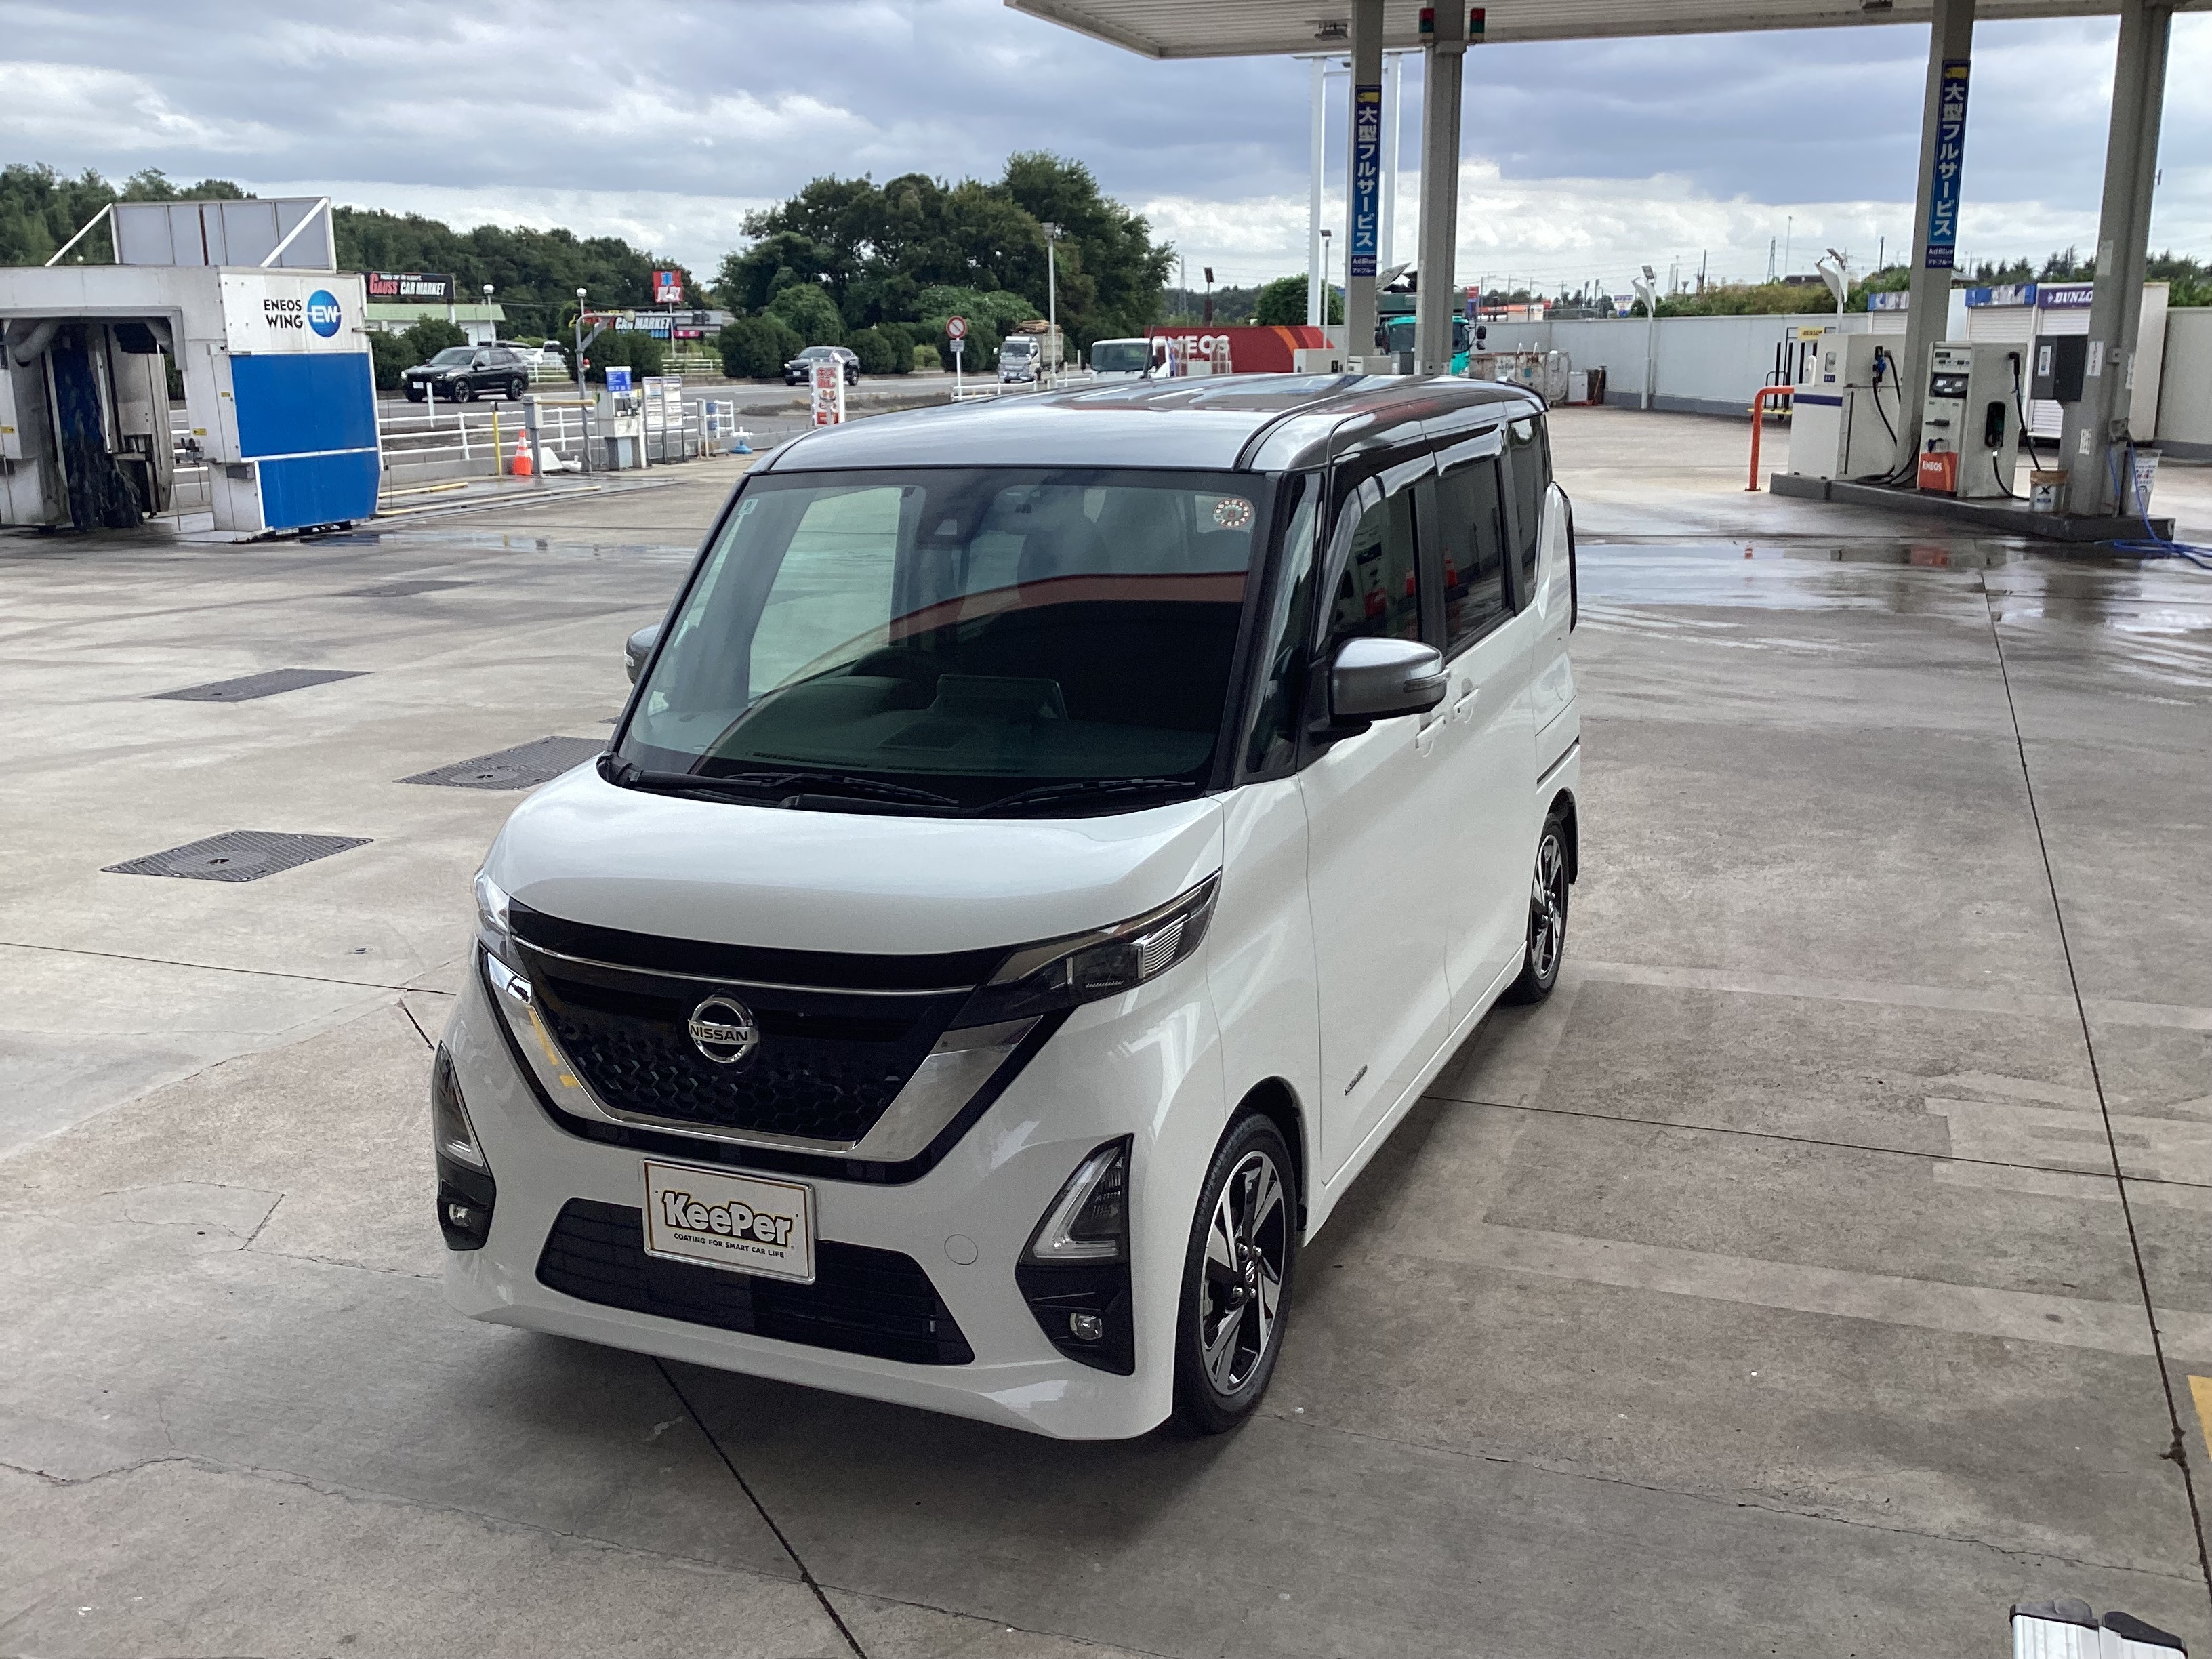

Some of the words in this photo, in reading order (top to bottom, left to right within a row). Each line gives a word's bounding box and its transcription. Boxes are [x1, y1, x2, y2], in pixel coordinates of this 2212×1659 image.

[1933, 83, 1965, 237] 大型フルサービス
[1356, 106, 1378, 247] 大型フルサービス
[400, 281, 415, 295] CAR
[415, 282, 446, 295] MARKET
[264, 299, 302, 312] ENEOS
[265, 314, 303, 329] WING
[634, 316, 670, 330] MARKET
[1153, 335, 1229, 354] NEOS
[1922, 460, 1942, 472] ENEOS
[690, 1025, 748, 1042] NISSAN
[662, 1190, 793, 1246] KeePer
[674, 1233, 706, 1244] COATING
[708, 1239, 723, 1247] FOR
[725, 1242, 750, 1252] SMART
[767, 1250, 785, 1258] LIFE
